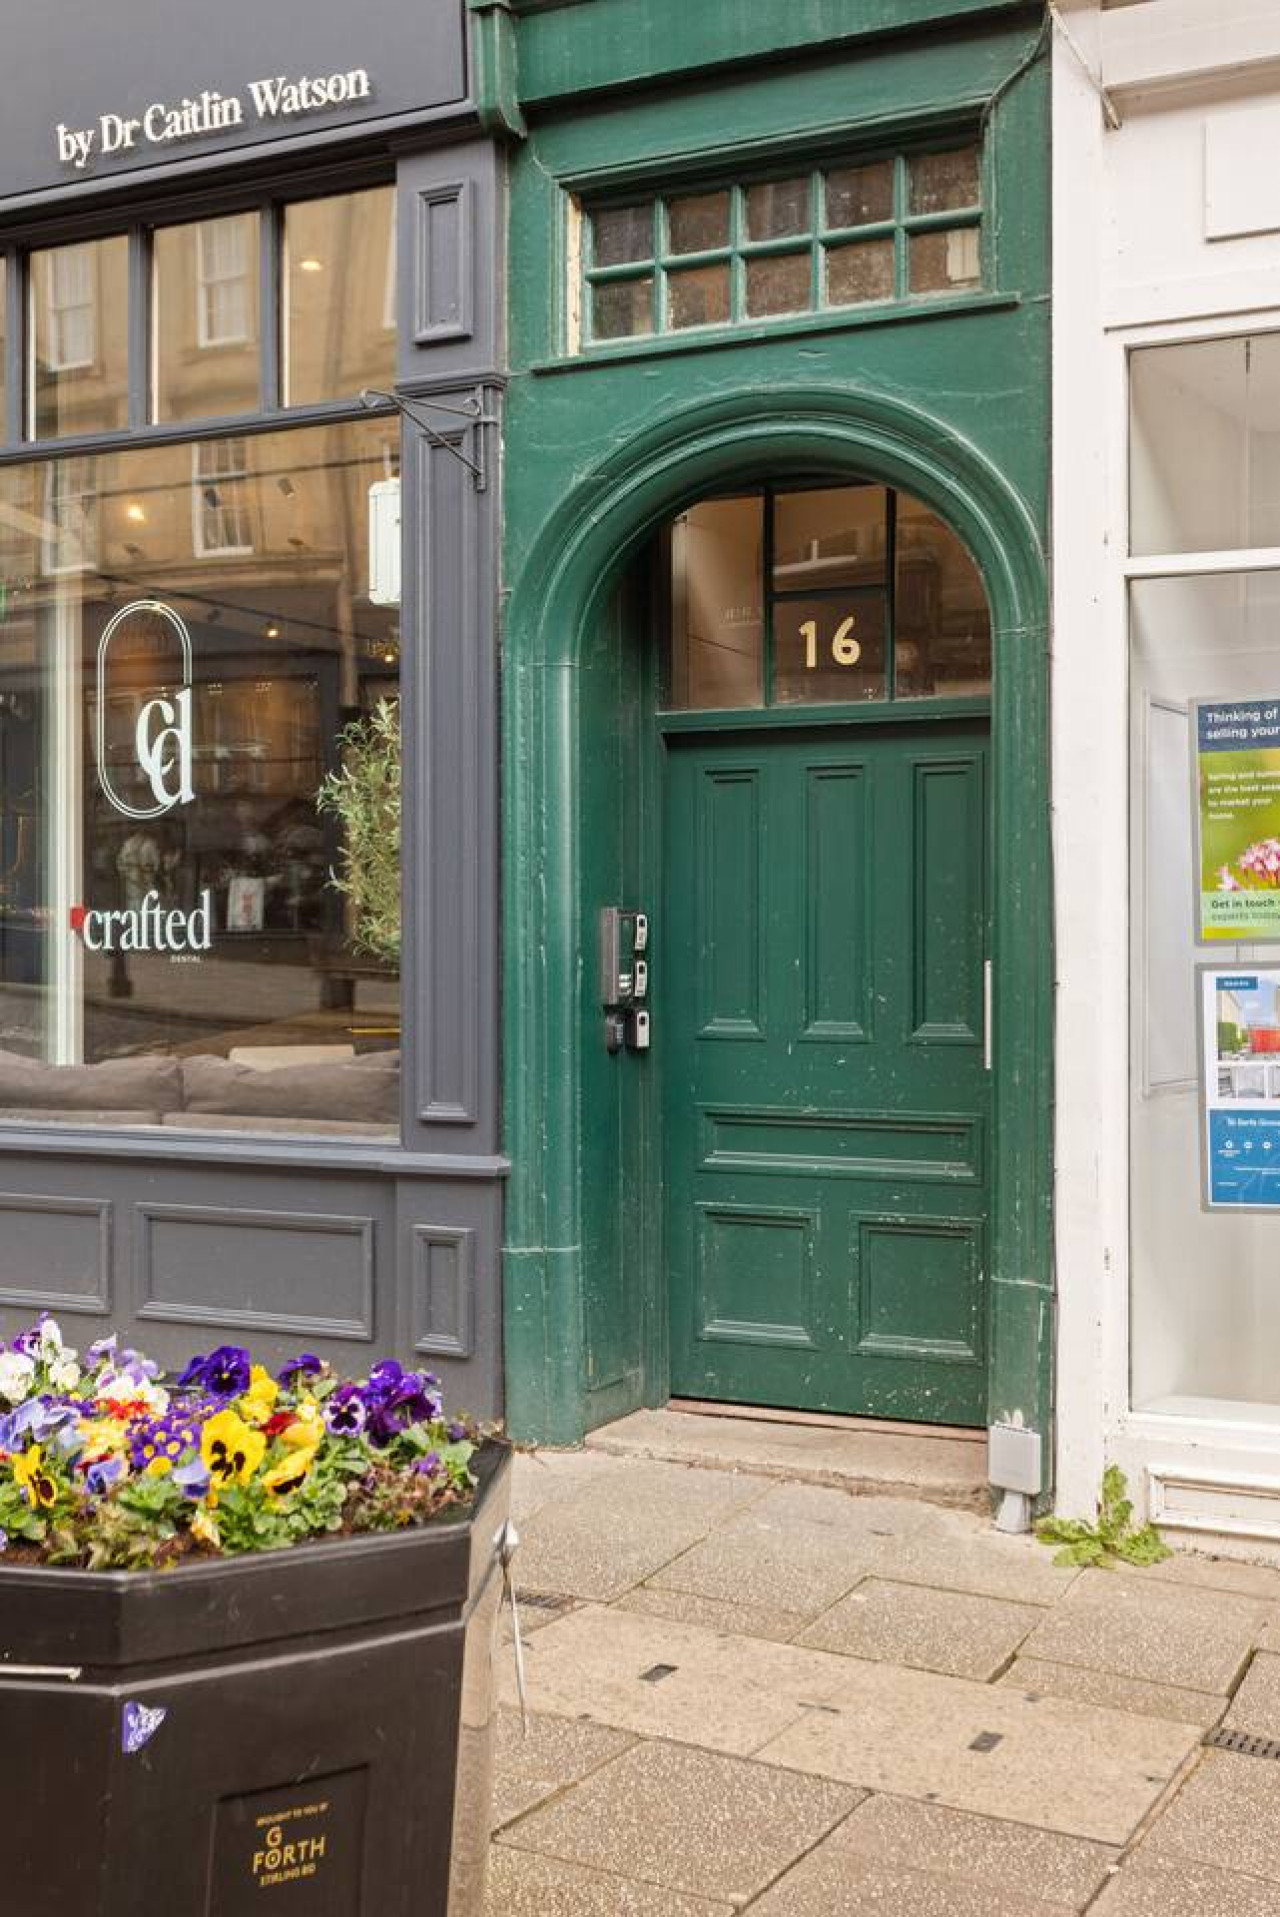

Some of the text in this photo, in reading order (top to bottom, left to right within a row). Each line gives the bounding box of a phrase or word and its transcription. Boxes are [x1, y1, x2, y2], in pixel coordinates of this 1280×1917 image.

[57, 68, 370, 167] by Dr Caitlin Watson
[799, 616, 861, 668] 16
[1206, 728, 1247, 740] selling
[1207, 707, 1278, 723] Thinking of
[83, 888, 212, 950] crafted
[1211, 897, 1275, 909] Get in touch
[252, 1835, 326, 1875] FORTH
